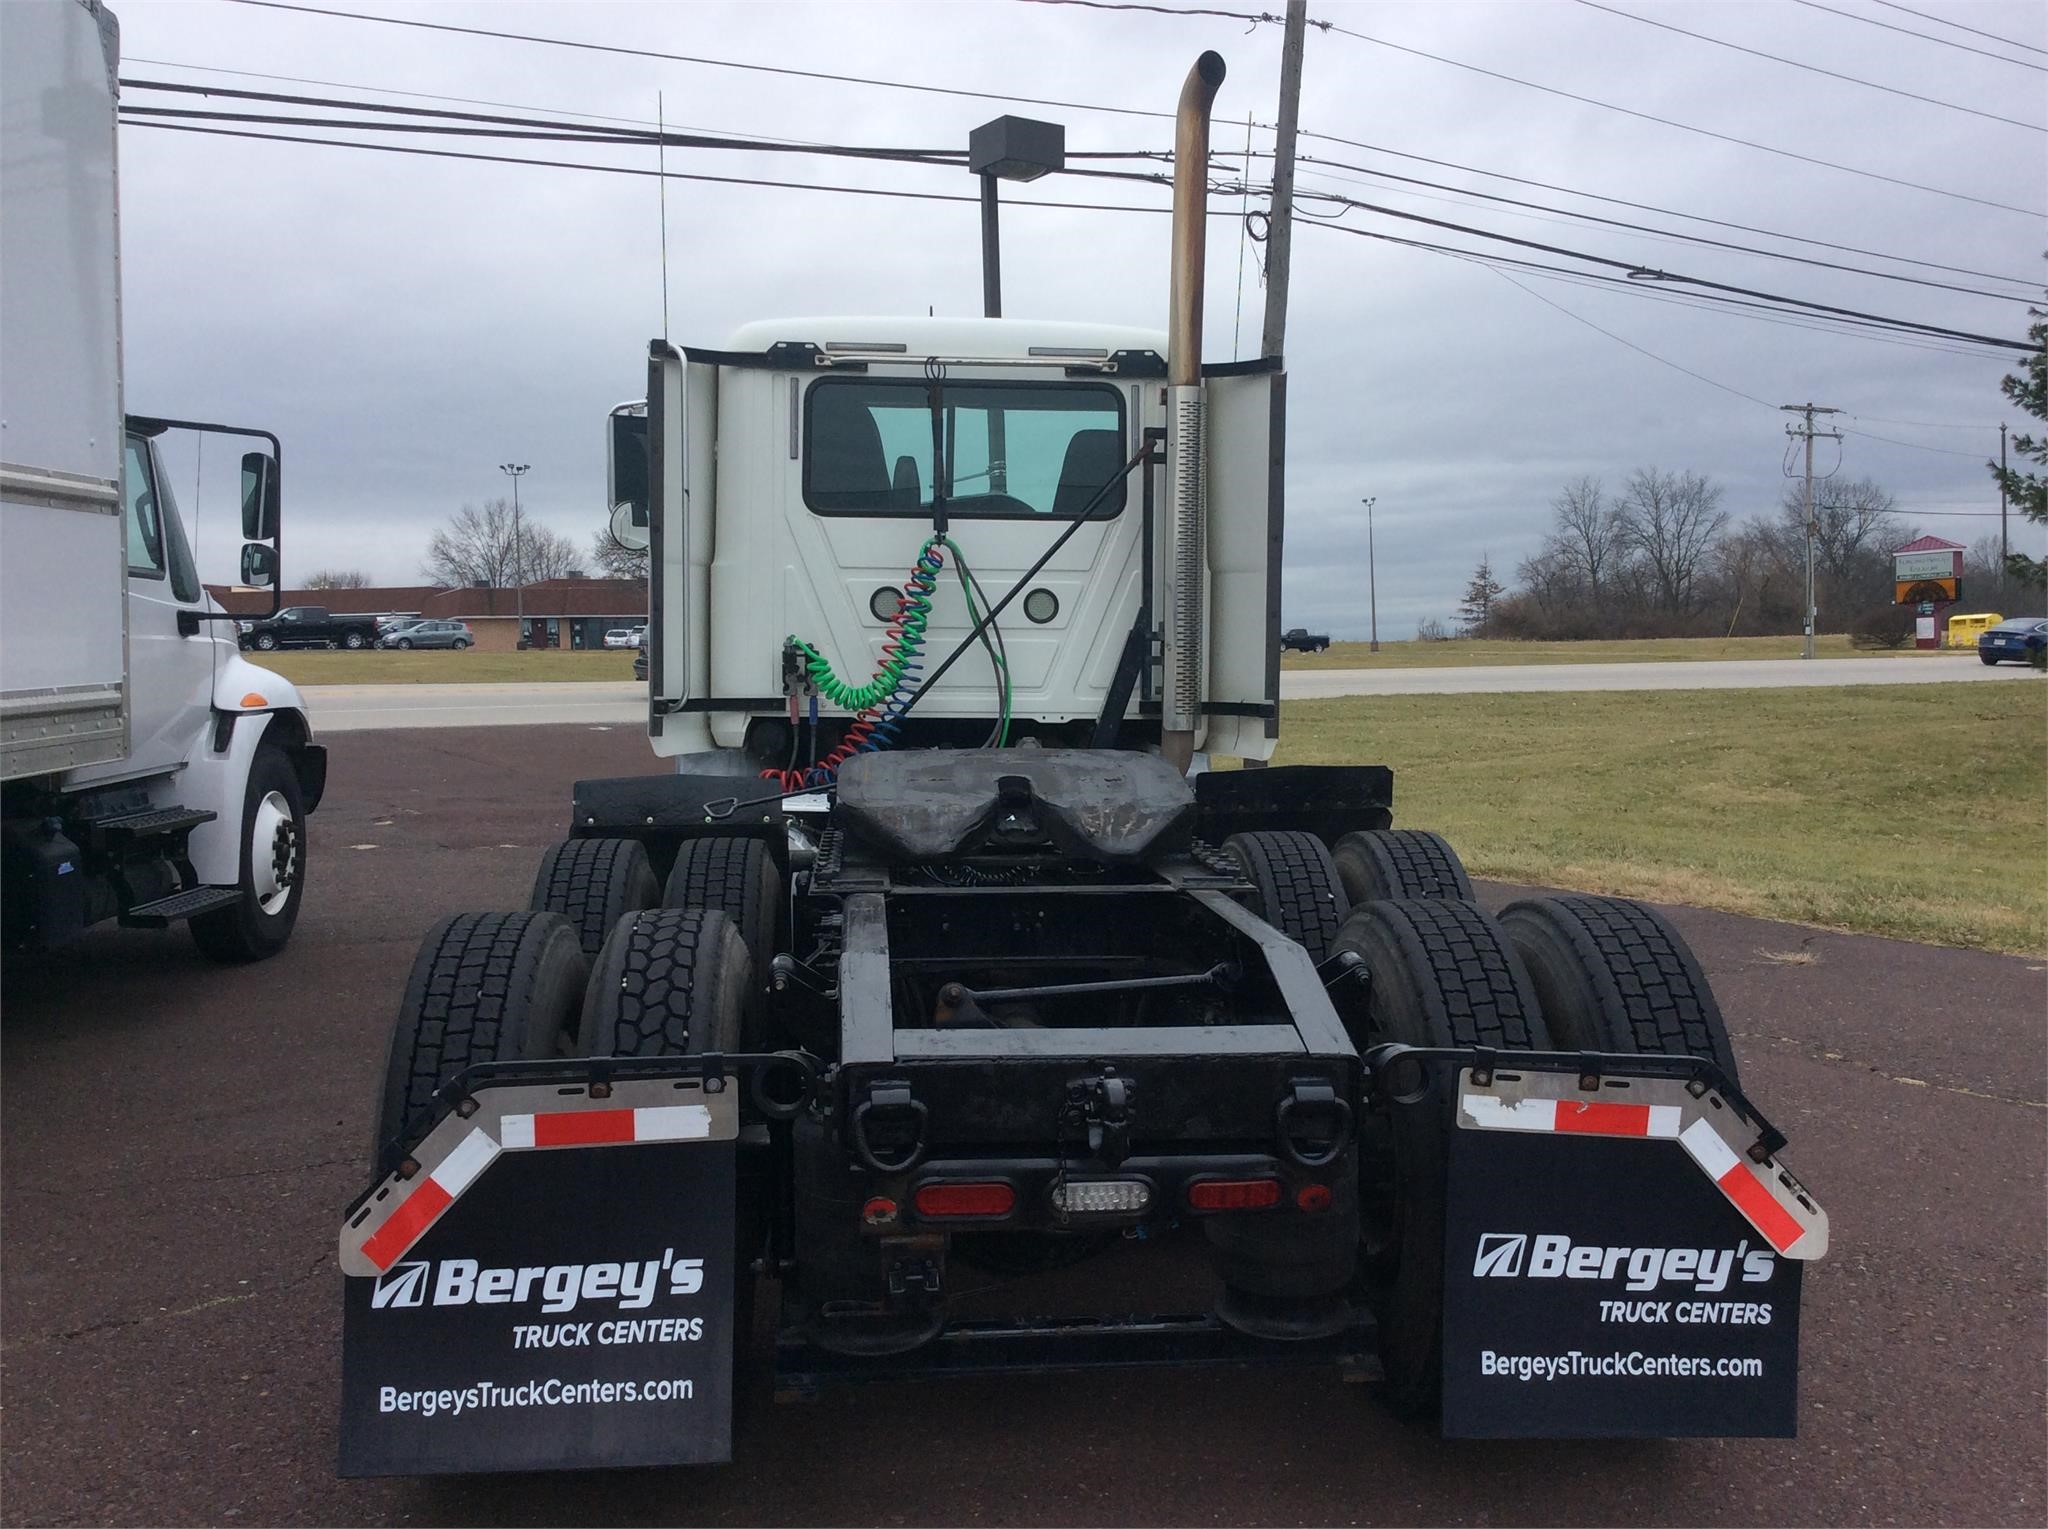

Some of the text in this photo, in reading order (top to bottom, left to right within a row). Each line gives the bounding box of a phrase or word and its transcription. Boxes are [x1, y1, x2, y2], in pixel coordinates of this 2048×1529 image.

[1528, 1234, 1776, 1292] Bergey's
[433, 1248, 704, 1314] Bergey's
[1600, 1301, 1773, 1325] TRUCK CENTERS
[512, 1318, 704, 1349] TRUCK CENTERS
[1481, 1350, 1763, 1381] BergeysTruckCenters.com
[379, 1378, 693, 1417] BergeysTruckCenters.com
